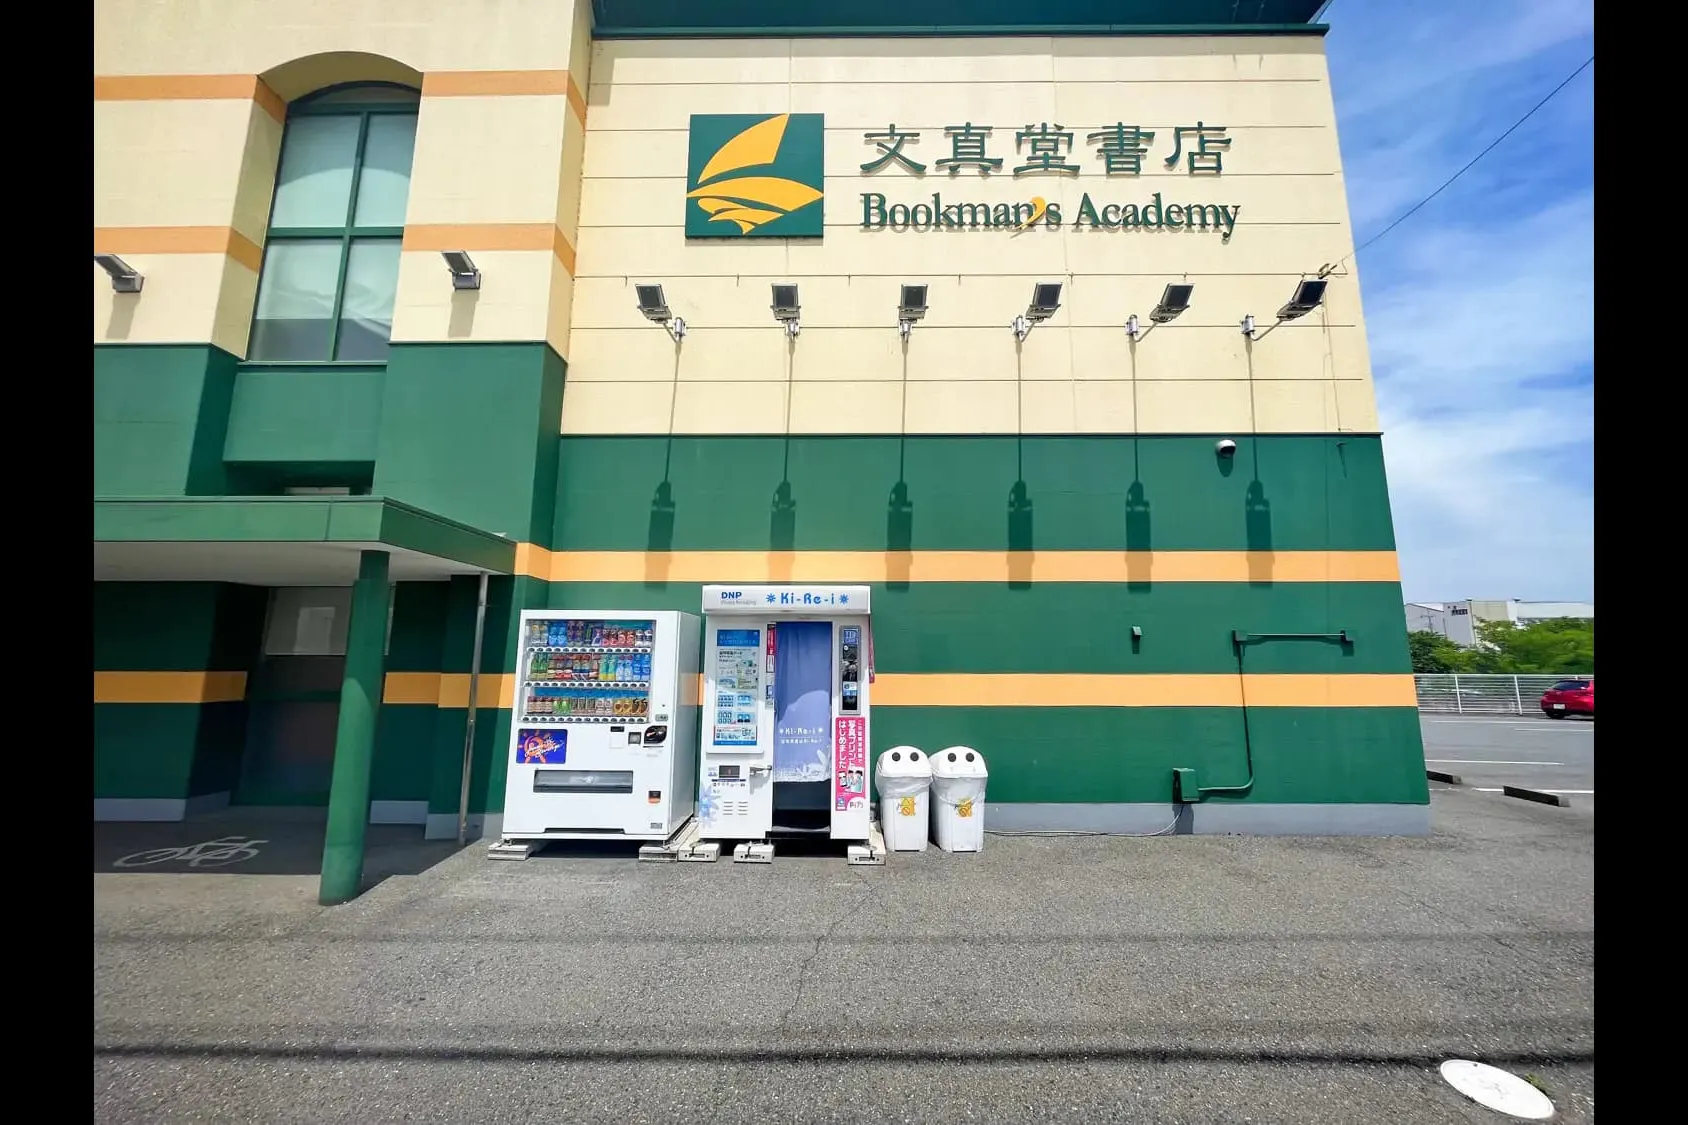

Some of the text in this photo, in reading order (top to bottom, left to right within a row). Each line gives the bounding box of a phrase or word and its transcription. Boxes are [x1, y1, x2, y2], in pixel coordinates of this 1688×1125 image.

[860, 121, 1232, 176] 文真堂書店
[860, 191, 1241, 239] Bookman's Academy
[721, 591, 742, 599] DNP
[780, 592, 835, 604] Ki-Re-i
